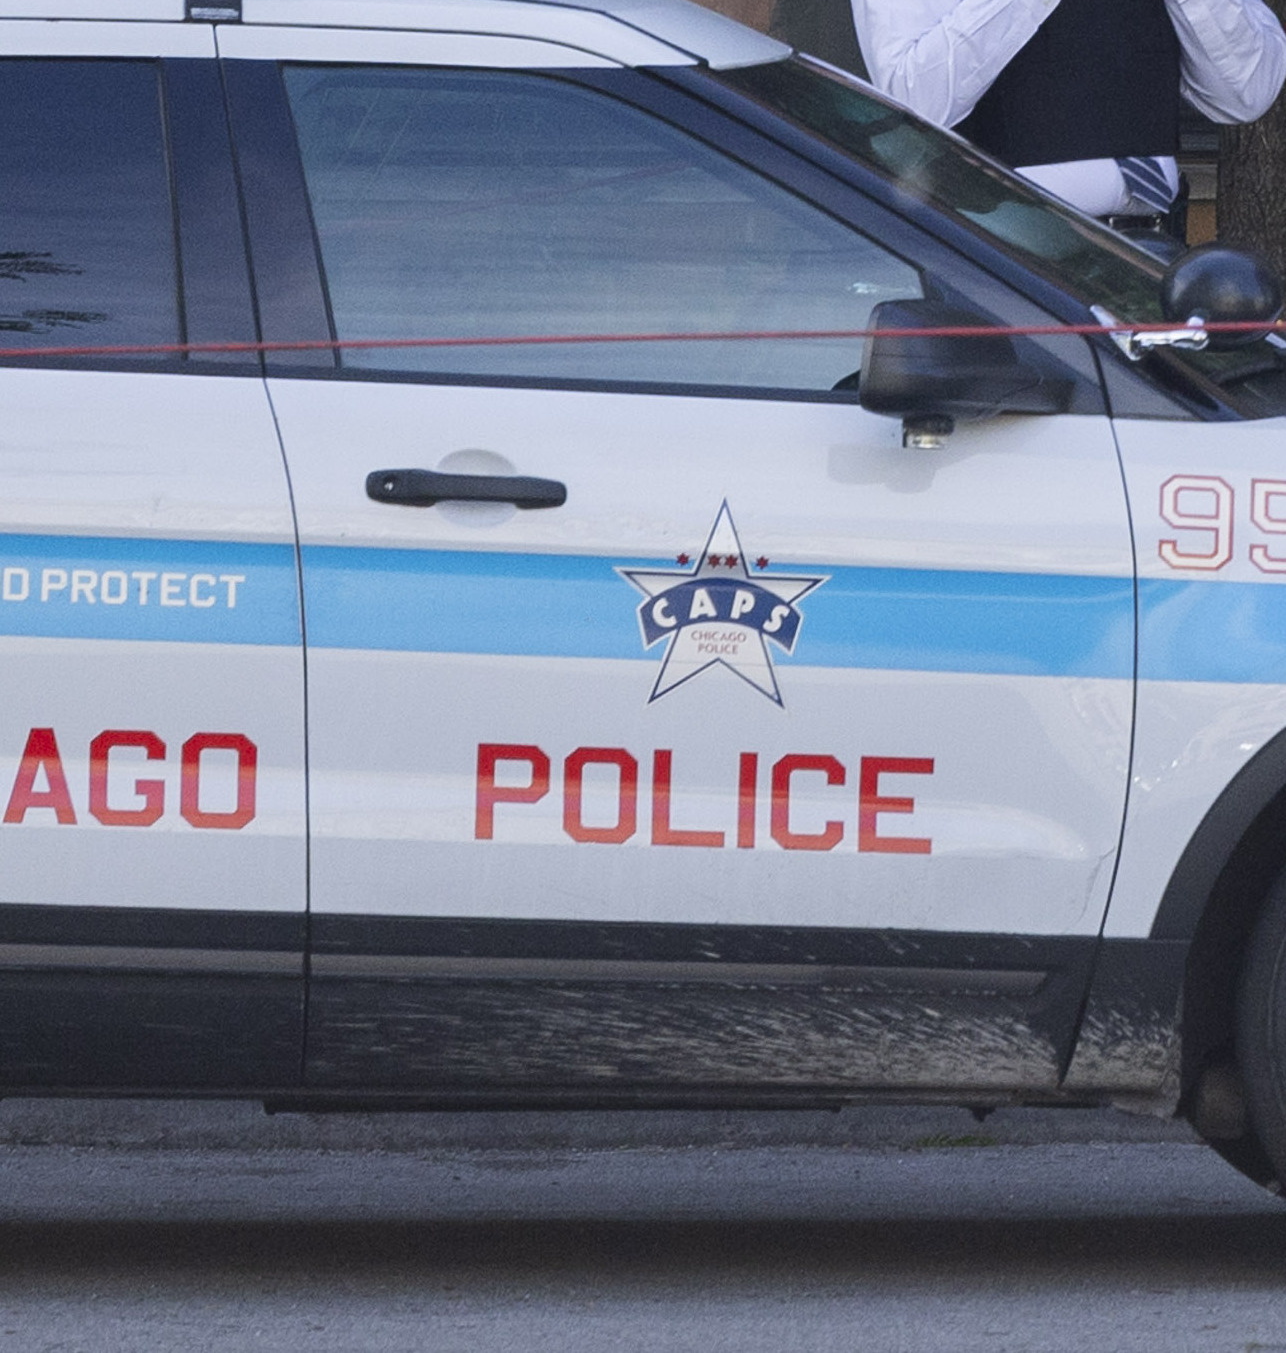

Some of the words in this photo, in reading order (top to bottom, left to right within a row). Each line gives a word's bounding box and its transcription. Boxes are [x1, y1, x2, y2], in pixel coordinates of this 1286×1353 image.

[41, 568, 246, 609] PROTECT
[652, 588, 791, 633] CAPS
[690, 630, 747, 643] CHICAGO
[697, 643, 739, 654] POLICE
[2, 727, 257, 830] AGO
[474, 742, 935, 854] POLICE
